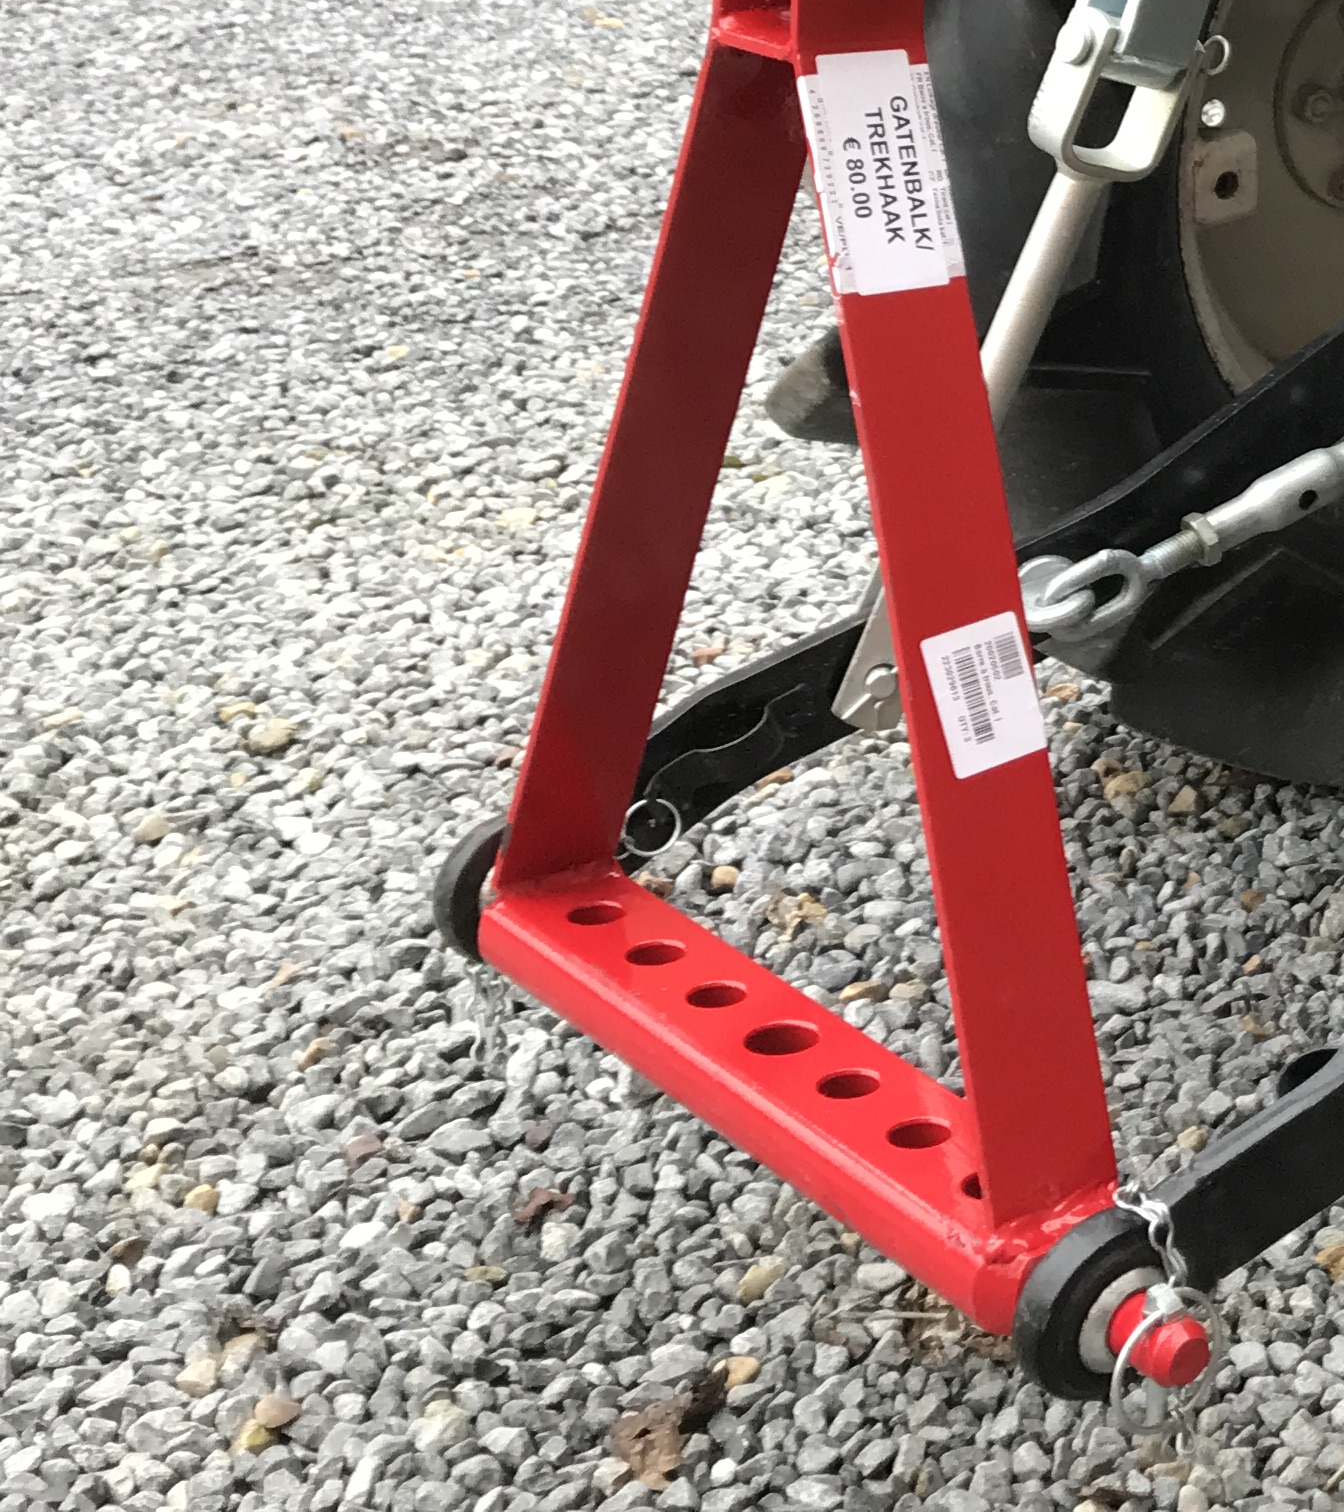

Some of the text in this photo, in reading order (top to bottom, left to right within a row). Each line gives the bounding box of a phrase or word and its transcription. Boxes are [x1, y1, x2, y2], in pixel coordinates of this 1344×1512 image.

[843, 137, 872, 218] € 80.00
[864, 107, 905, 244] TREKHAAK
[890, 95, 934, 250] GATENBALK/
